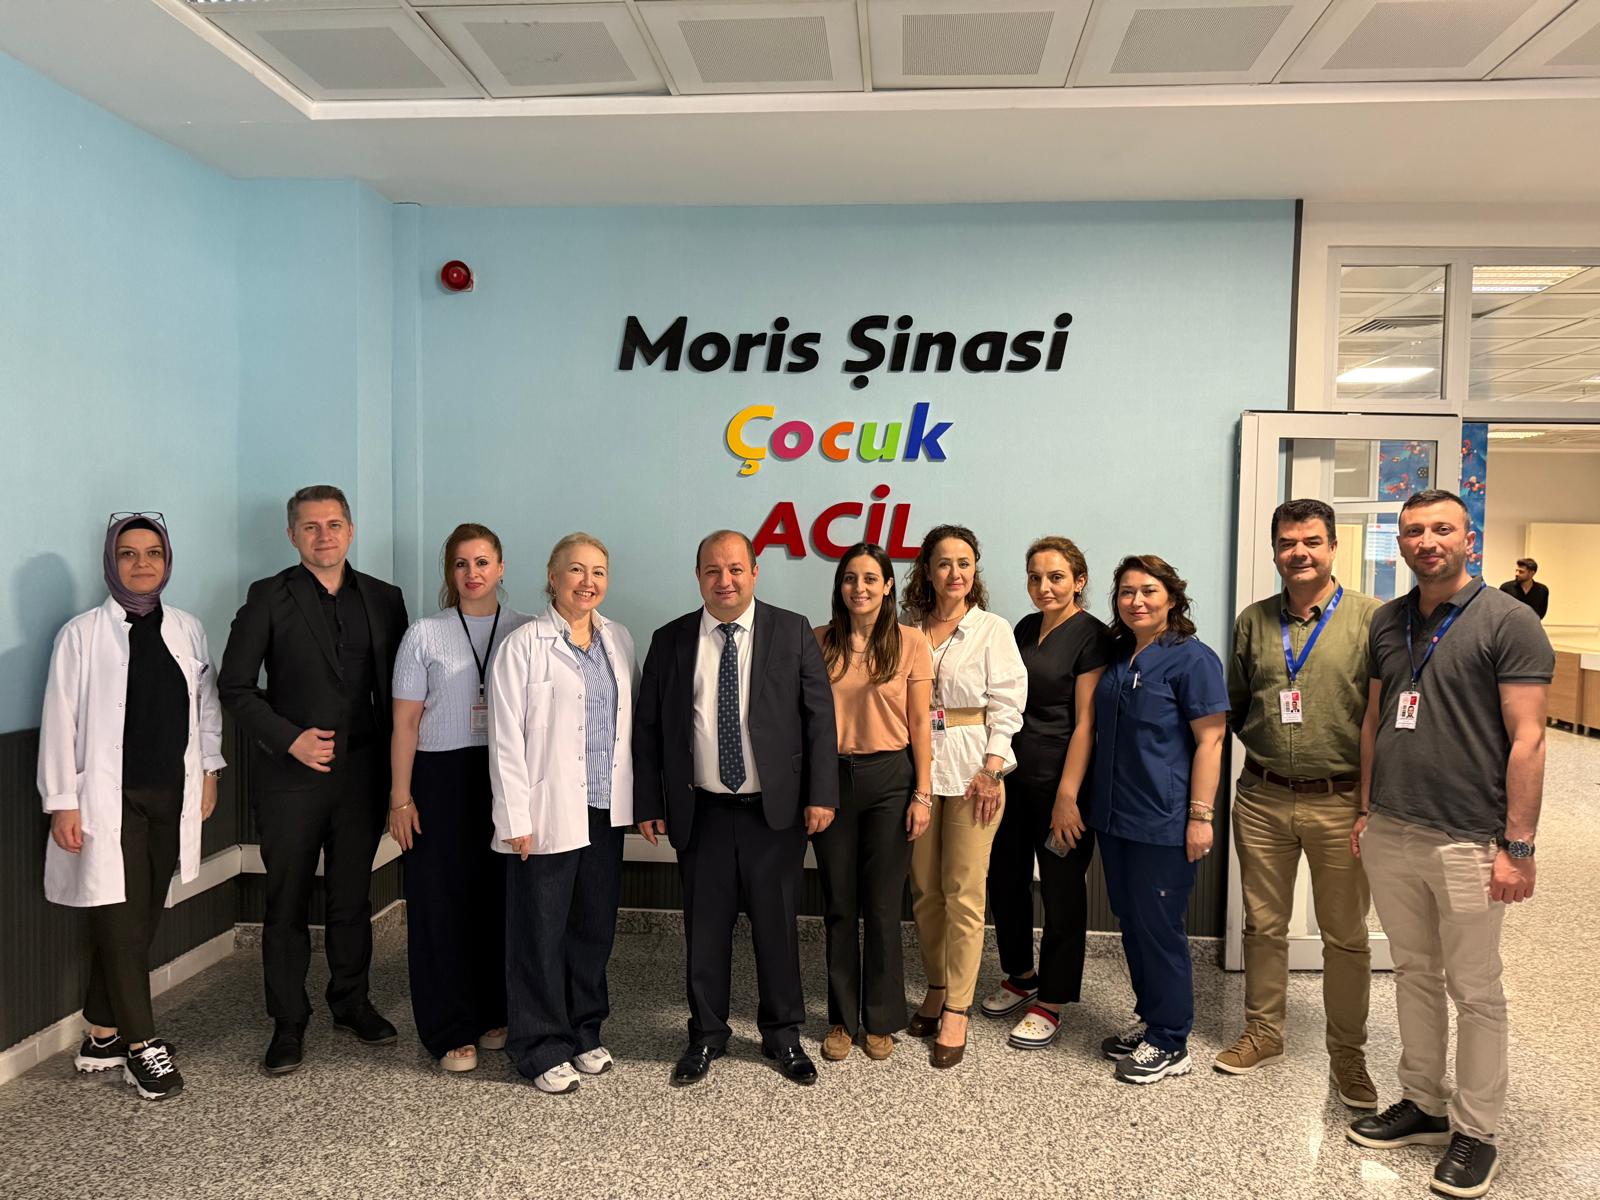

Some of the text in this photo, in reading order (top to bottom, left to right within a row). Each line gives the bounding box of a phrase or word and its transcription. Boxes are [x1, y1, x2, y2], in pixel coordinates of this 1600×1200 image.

[617, 312, 1073, 390] Moris Şinasi
[725, 402, 953, 476] Çocuk
[751, 484, 924, 561] ACİL
